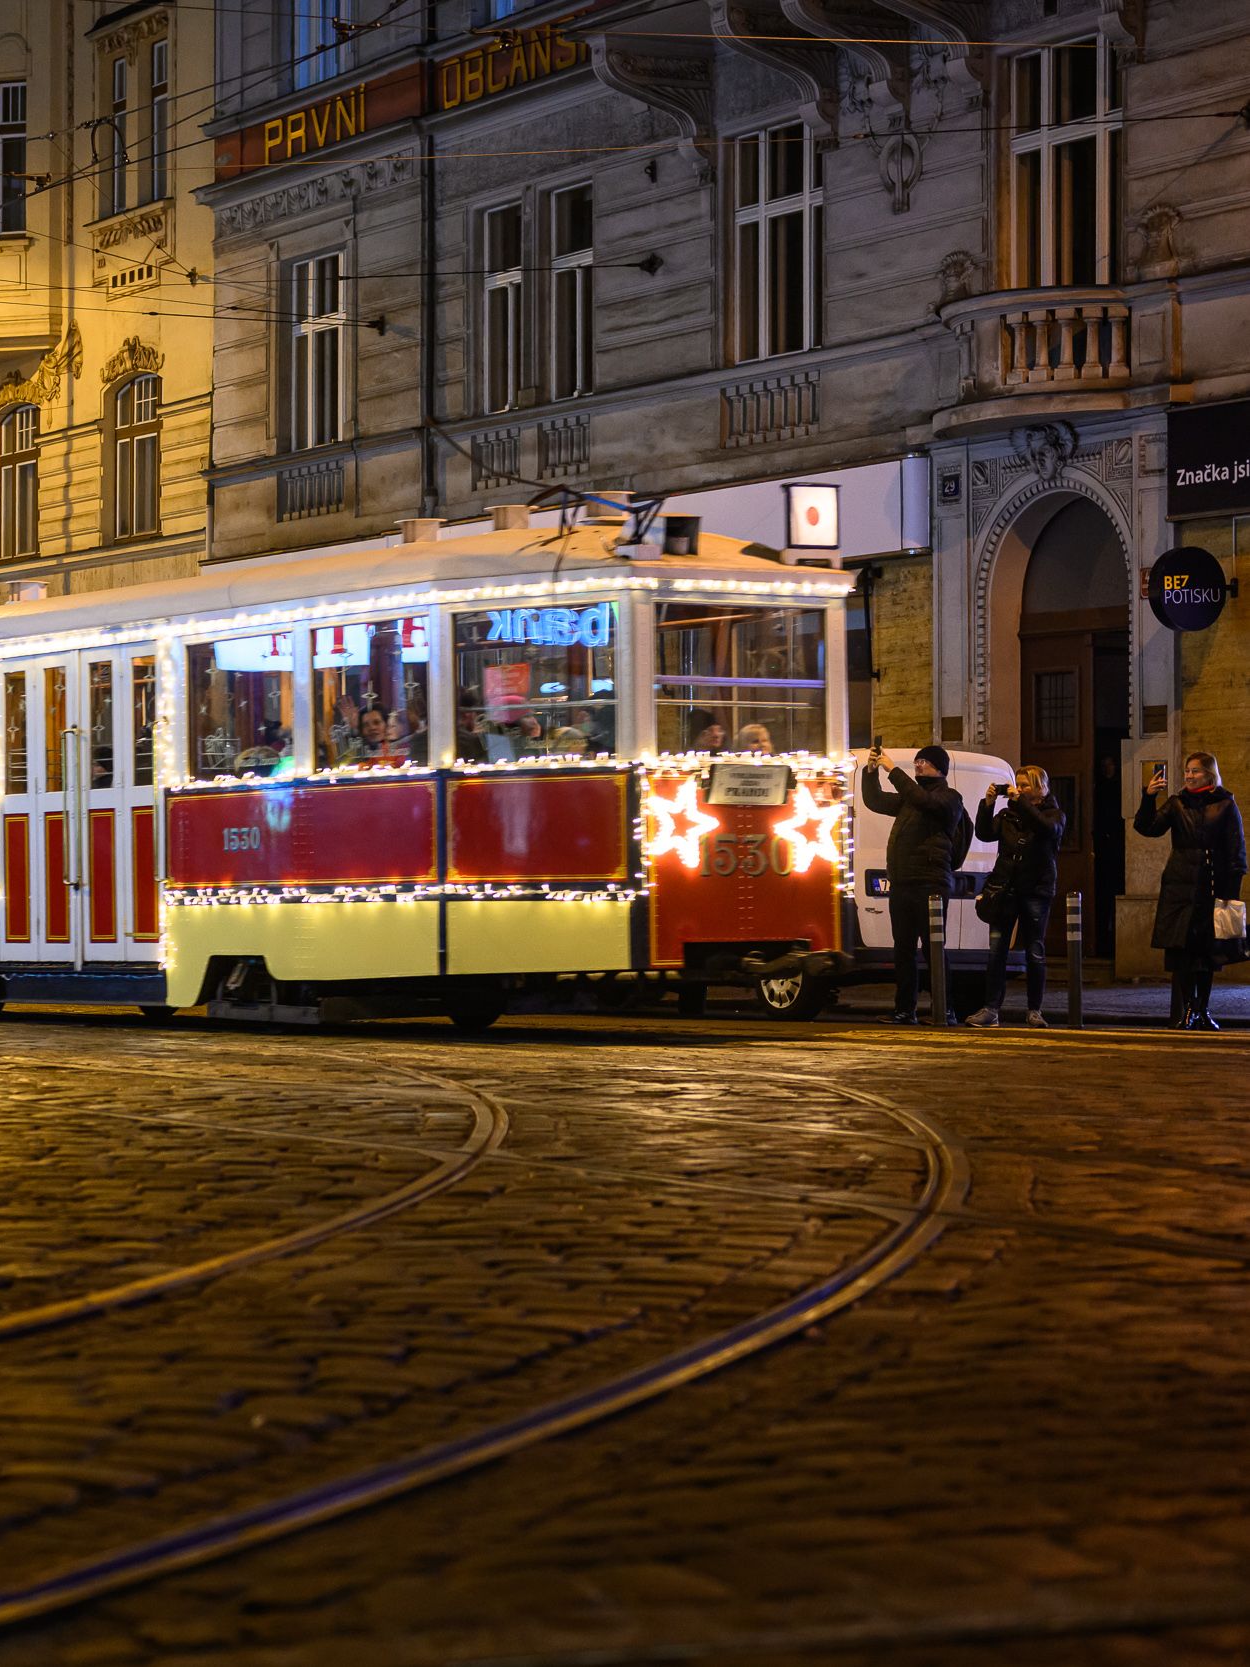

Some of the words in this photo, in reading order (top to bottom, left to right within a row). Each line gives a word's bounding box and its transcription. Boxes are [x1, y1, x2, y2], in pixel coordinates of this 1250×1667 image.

[264, 82, 366, 165] PRVNÍ
[944, 480, 956, 493] 29
[1176, 462, 1229, 486] Značka
[1164, 587, 1221, 605] POTISKU
[222, 826, 262, 854] 1530
[699, 833, 796, 877] 1530
